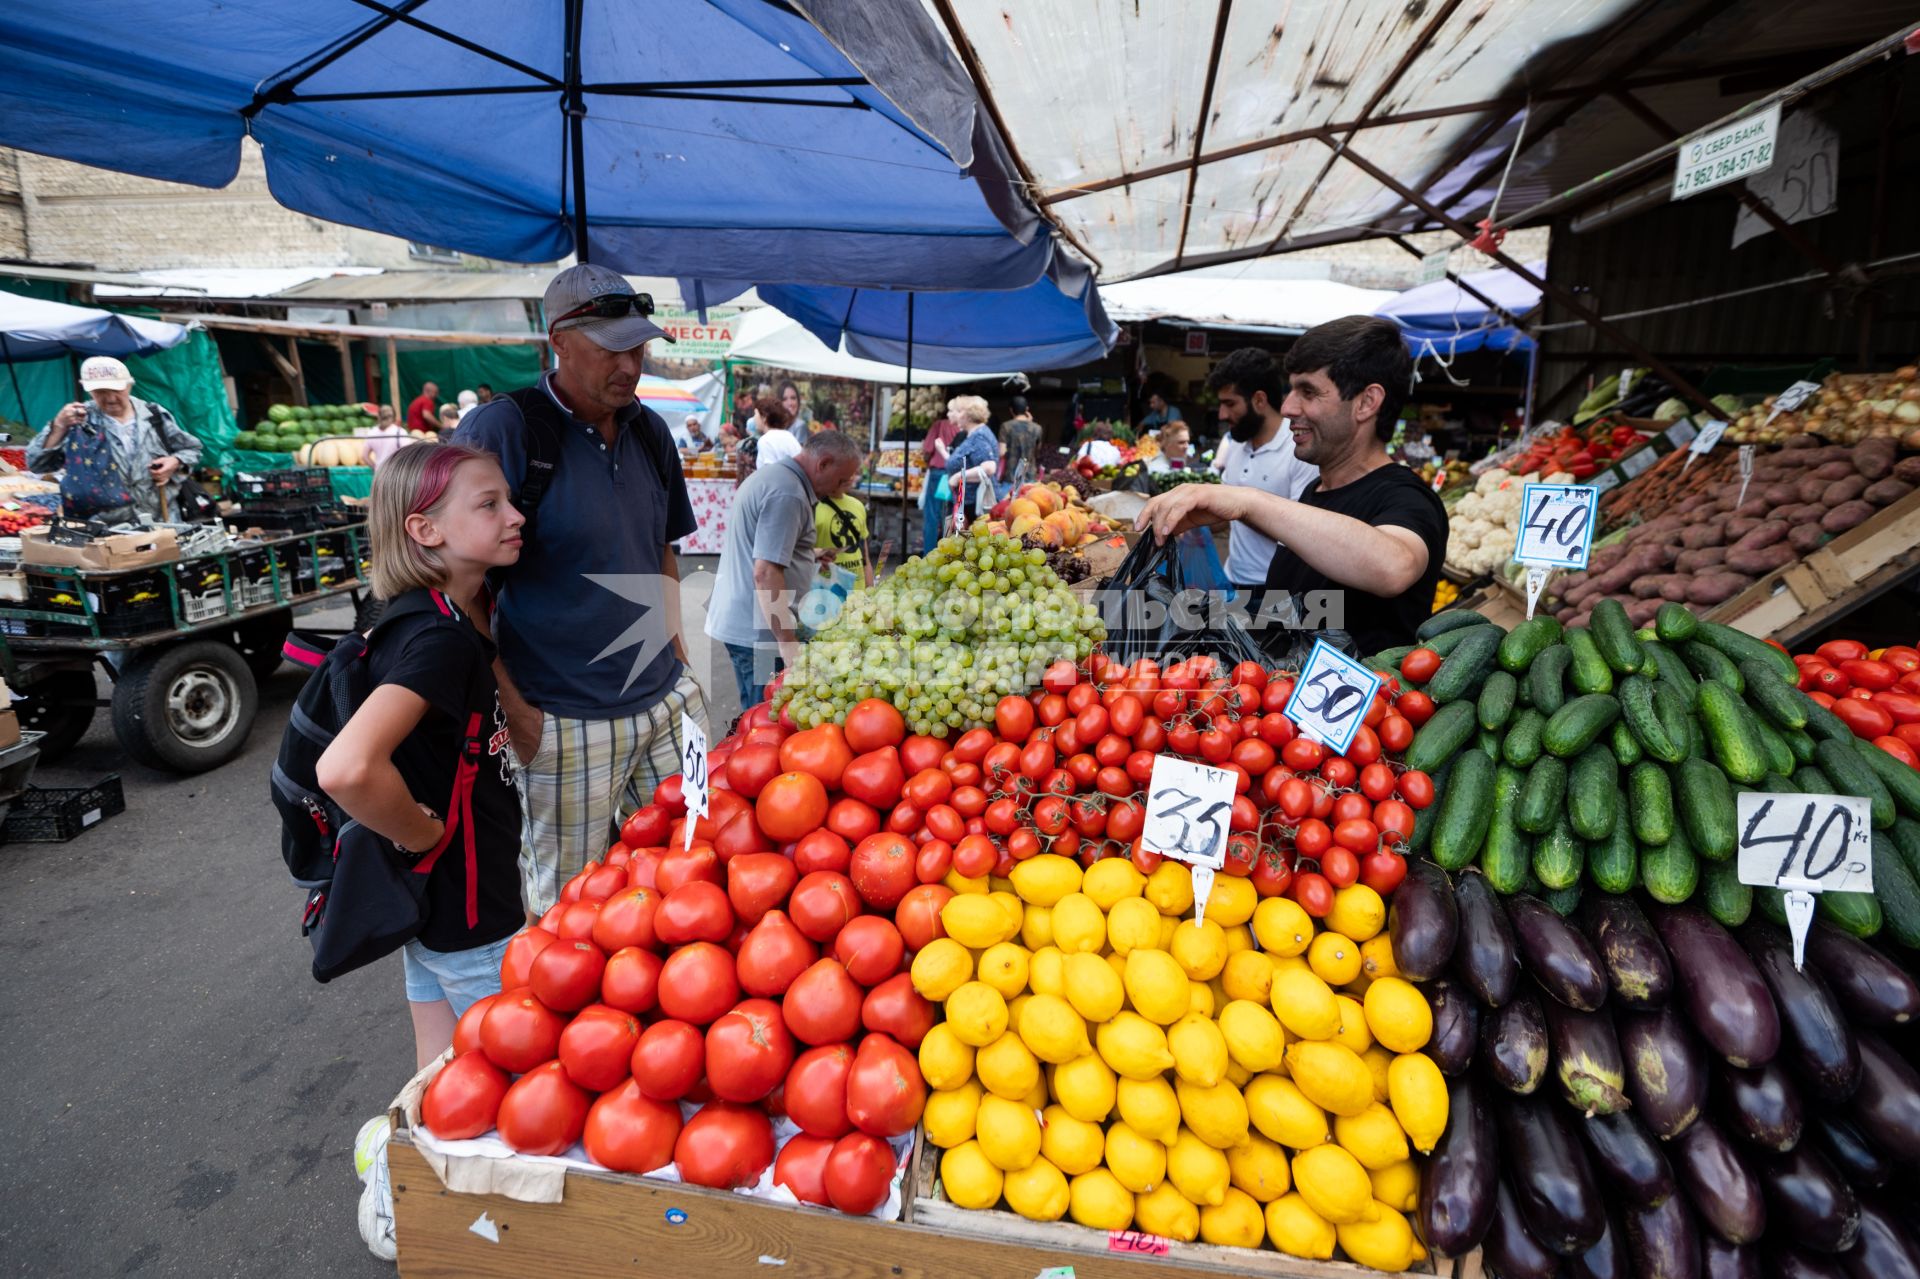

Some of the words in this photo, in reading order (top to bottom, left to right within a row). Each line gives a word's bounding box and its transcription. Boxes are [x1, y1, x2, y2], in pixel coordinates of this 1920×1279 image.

[1705, 134, 1734, 156] СБЕР
[1735, 119, 1767, 145] БАНК
[1677, 173, 1691, 191] +7
[1693, 165, 1712, 186] 952
[1716, 142, 1773, 179] 264-57-82
[662, 325, 733, 341] МЕСТА
[1525, 494, 1590, 547] 40
[1296, 668, 1366, 723] 50
[683, 740, 706, 791] 50
[1144, 787, 1233, 858] 35
[1740, 799, 1854, 885] 40
[1116, 1230, 1155, 1252] 40
